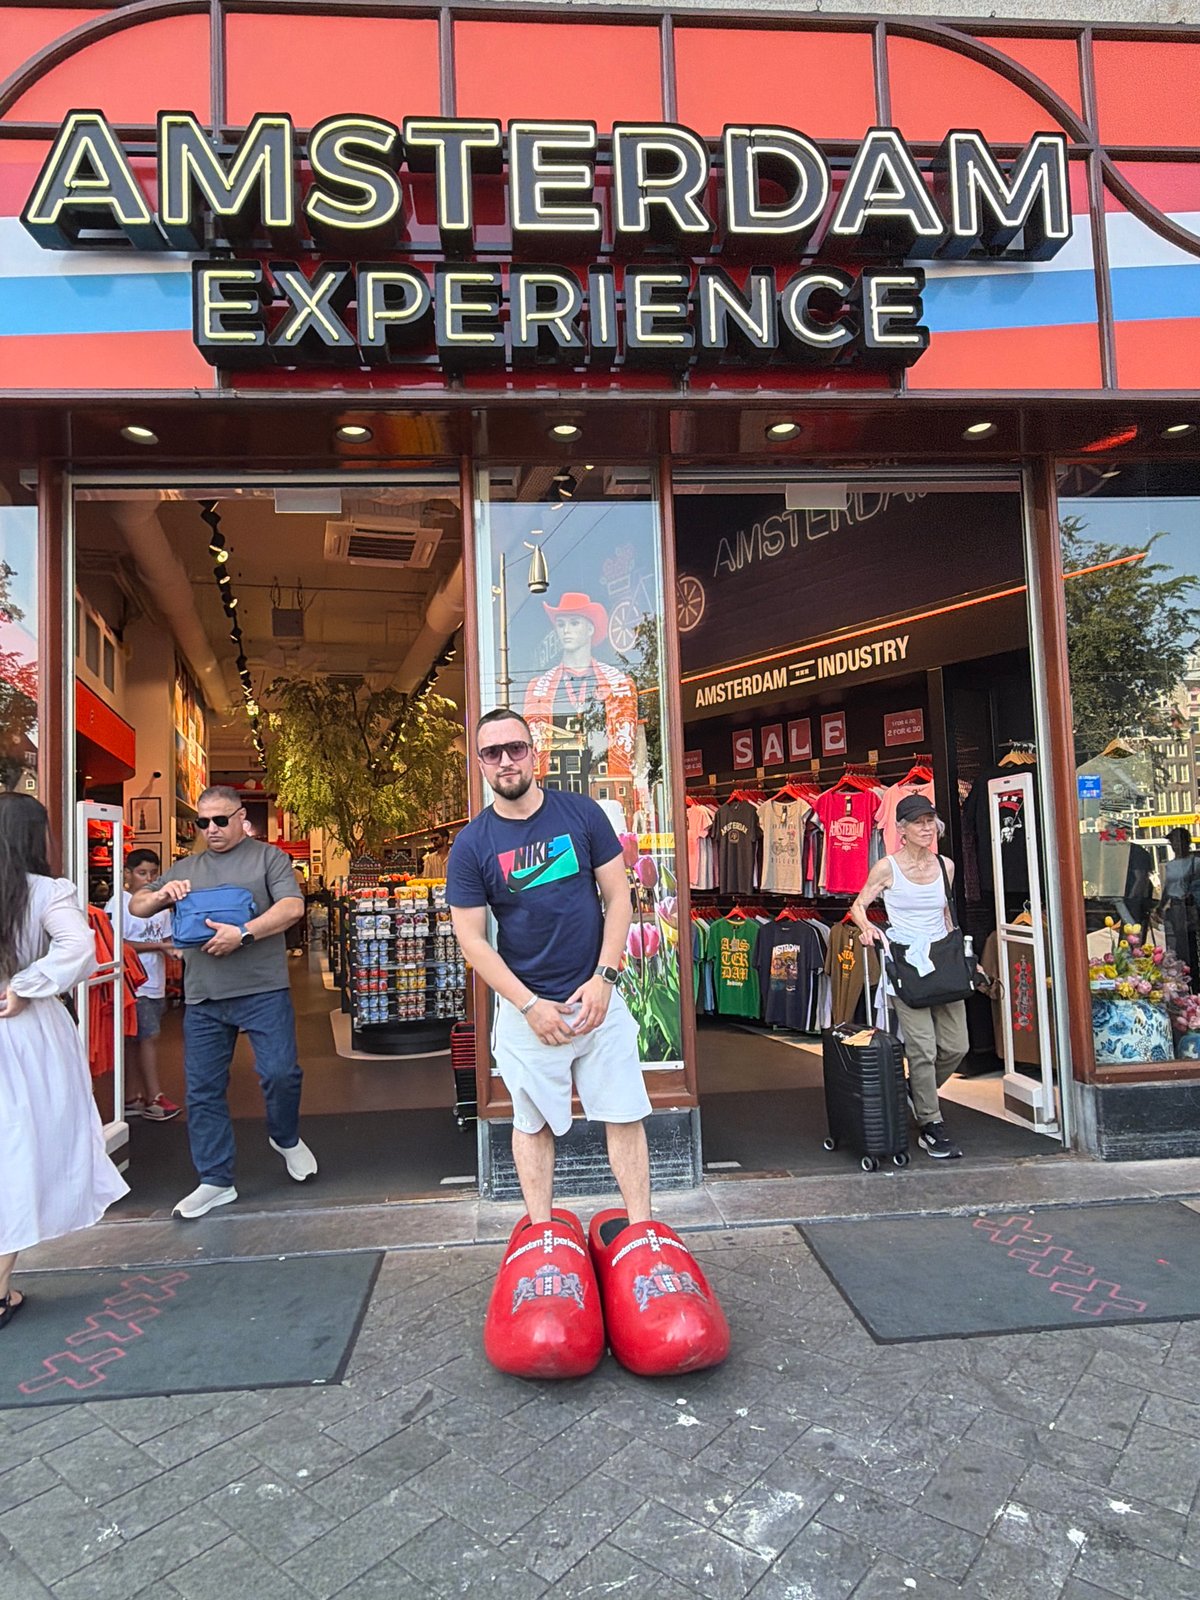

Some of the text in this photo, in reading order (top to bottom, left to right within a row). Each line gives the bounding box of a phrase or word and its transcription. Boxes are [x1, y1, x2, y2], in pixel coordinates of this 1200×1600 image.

[23, 110, 1073, 240] AMSTERDAM
[194, 262, 930, 352] EXPERIENCE
[695, 635, 909, 708] AMSTERDAM INDUSTRY
[735, 720, 845, 764] SALE
[893, 728, 906, 736] FOR
[513, 836, 556, 872] NIKE
